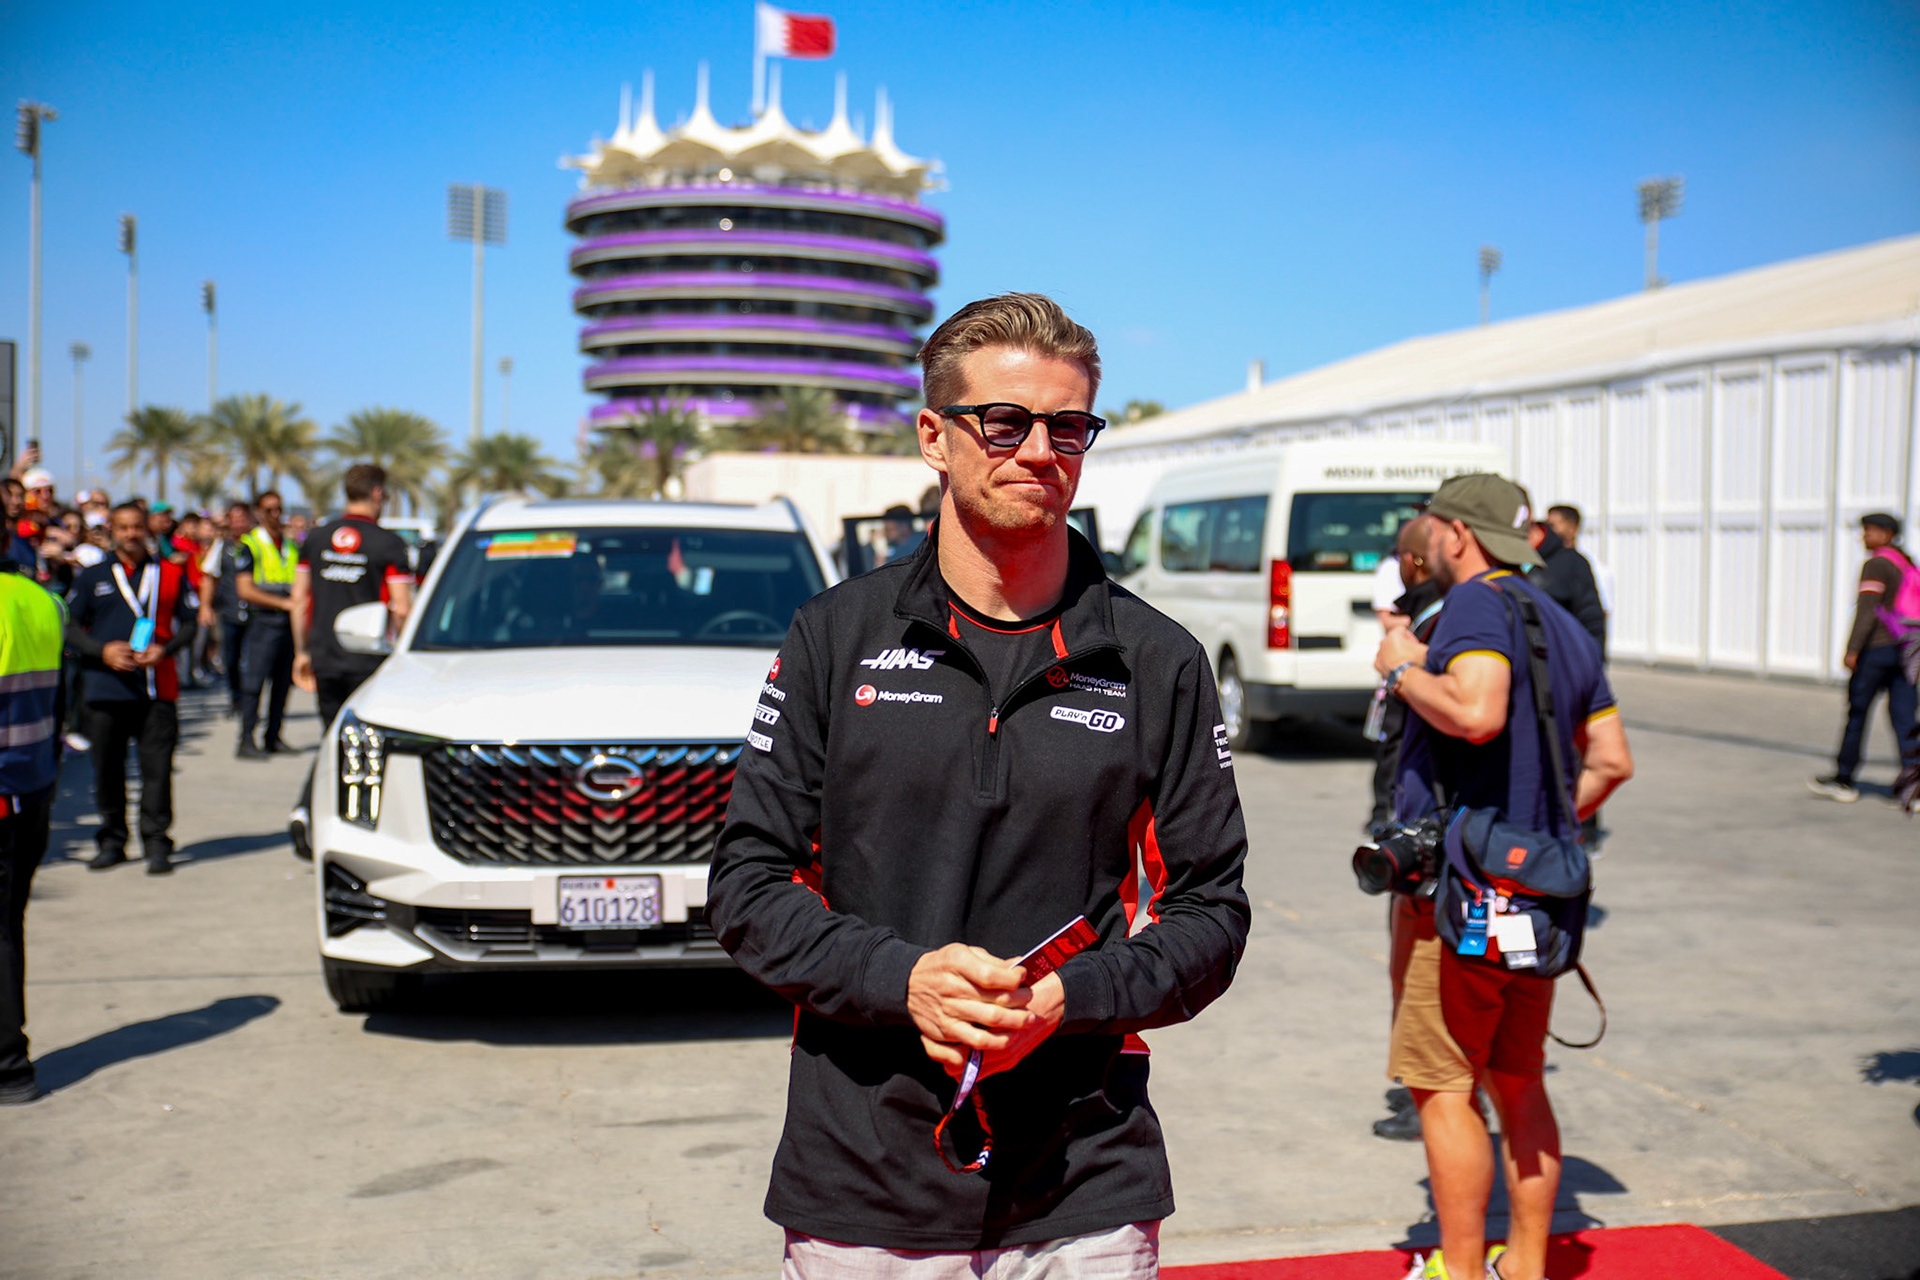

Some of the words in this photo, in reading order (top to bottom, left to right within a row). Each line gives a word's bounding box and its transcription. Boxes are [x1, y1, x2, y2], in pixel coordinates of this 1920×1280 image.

[860, 648, 946, 670] HAAS
[1069, 672, 1126, 691] MoneyGram
[877, 690, 943, 704] MoneyGram
[1103, 688, 1126, 698] TEAM
[1088, 711, 1118, 730] GO
[562, 897, 655, 922] 610128
